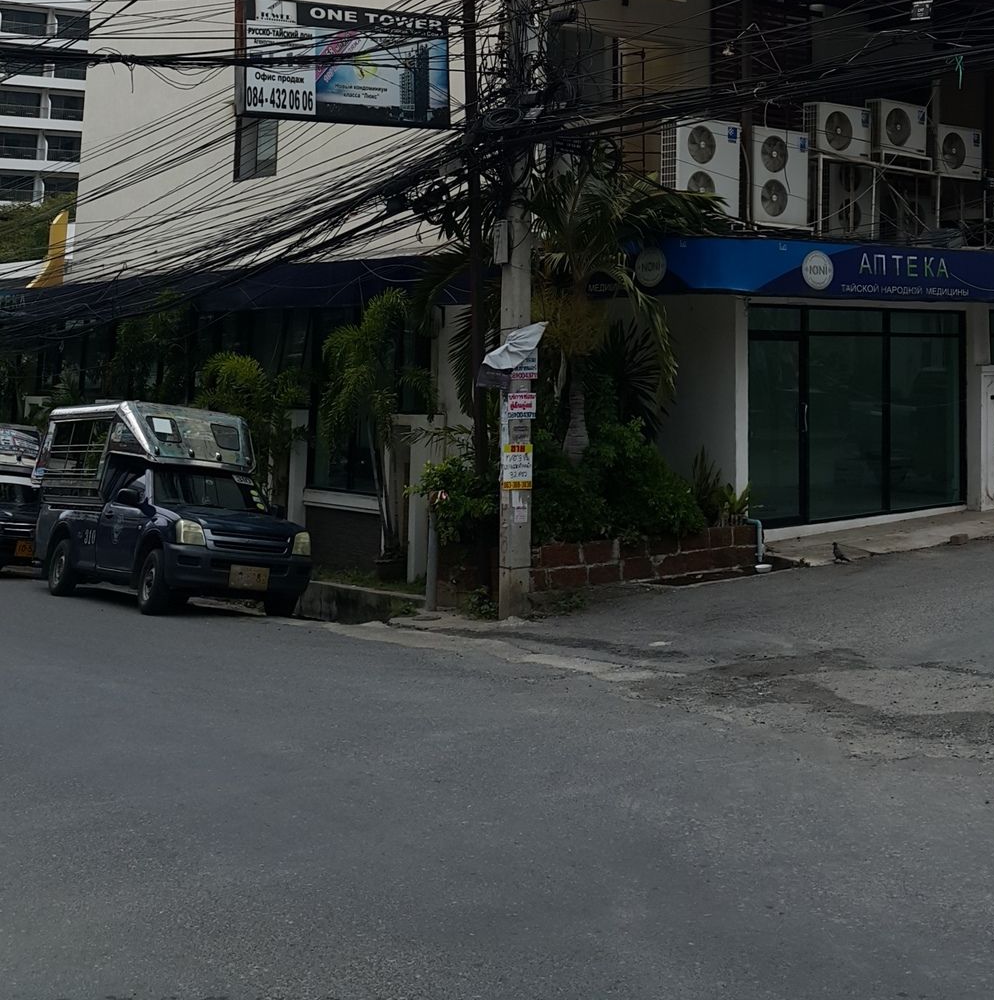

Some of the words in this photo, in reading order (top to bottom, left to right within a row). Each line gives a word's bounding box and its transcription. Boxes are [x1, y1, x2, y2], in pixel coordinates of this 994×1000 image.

[310, 7, 358, 23] ONE
[365, 12, 443, 32] TOWER
[254, 71, 276, 81] Офис
[277, 74, 305, 84] продаж
[289, 90, 301, 110] 06
[302, 91, 314, 111] 06
[859, 252, 950, 279] АПТЕКА
[841, 283, 880, 294] ТАЙСКОЙ
[881, 285, 923, 295] НАРОДНОЙ
[925, 287, 969, 297] МЕДИЦИНЫ
